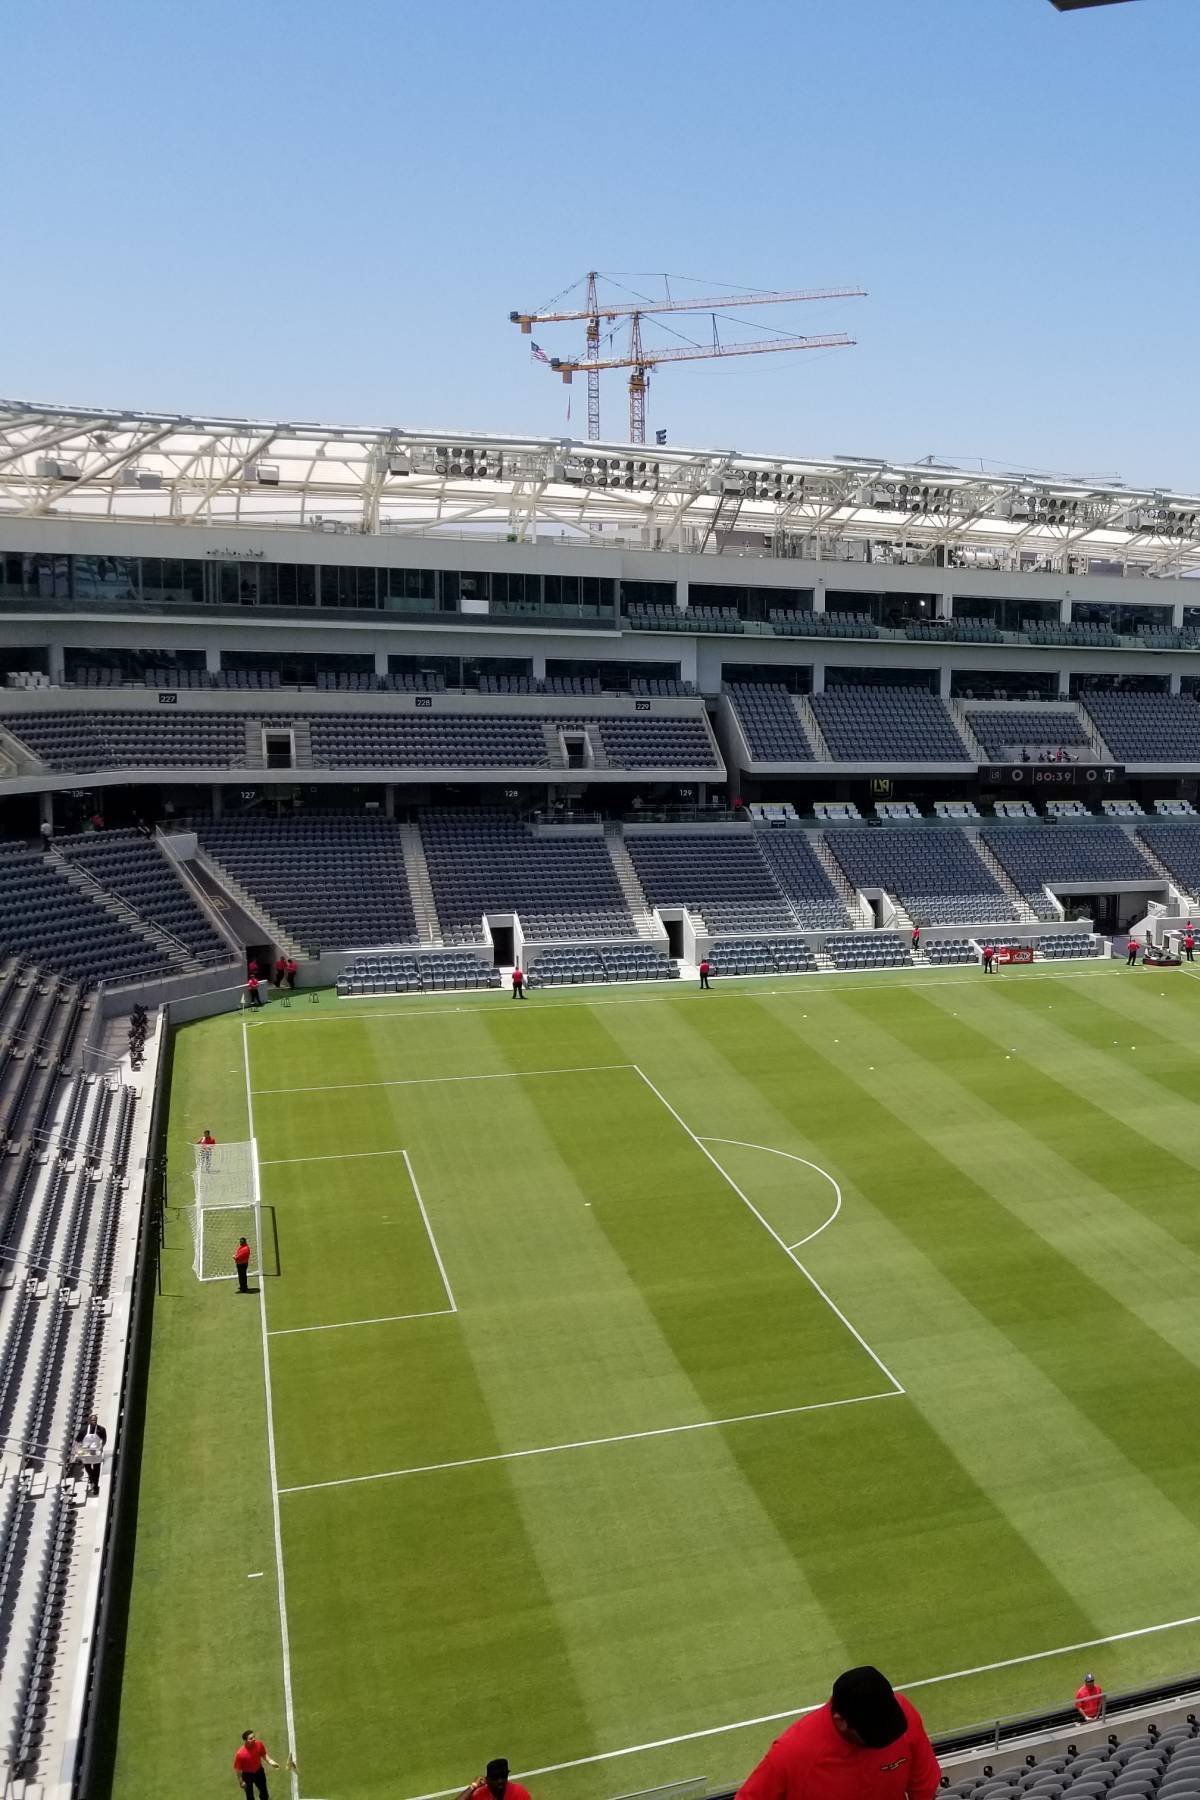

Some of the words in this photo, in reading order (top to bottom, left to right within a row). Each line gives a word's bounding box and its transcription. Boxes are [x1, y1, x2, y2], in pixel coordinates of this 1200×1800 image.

[160, 695, 175, 703] 227
[1036, 771, 1071, 782] 80:39
[240, 791, 256, 799] 127
